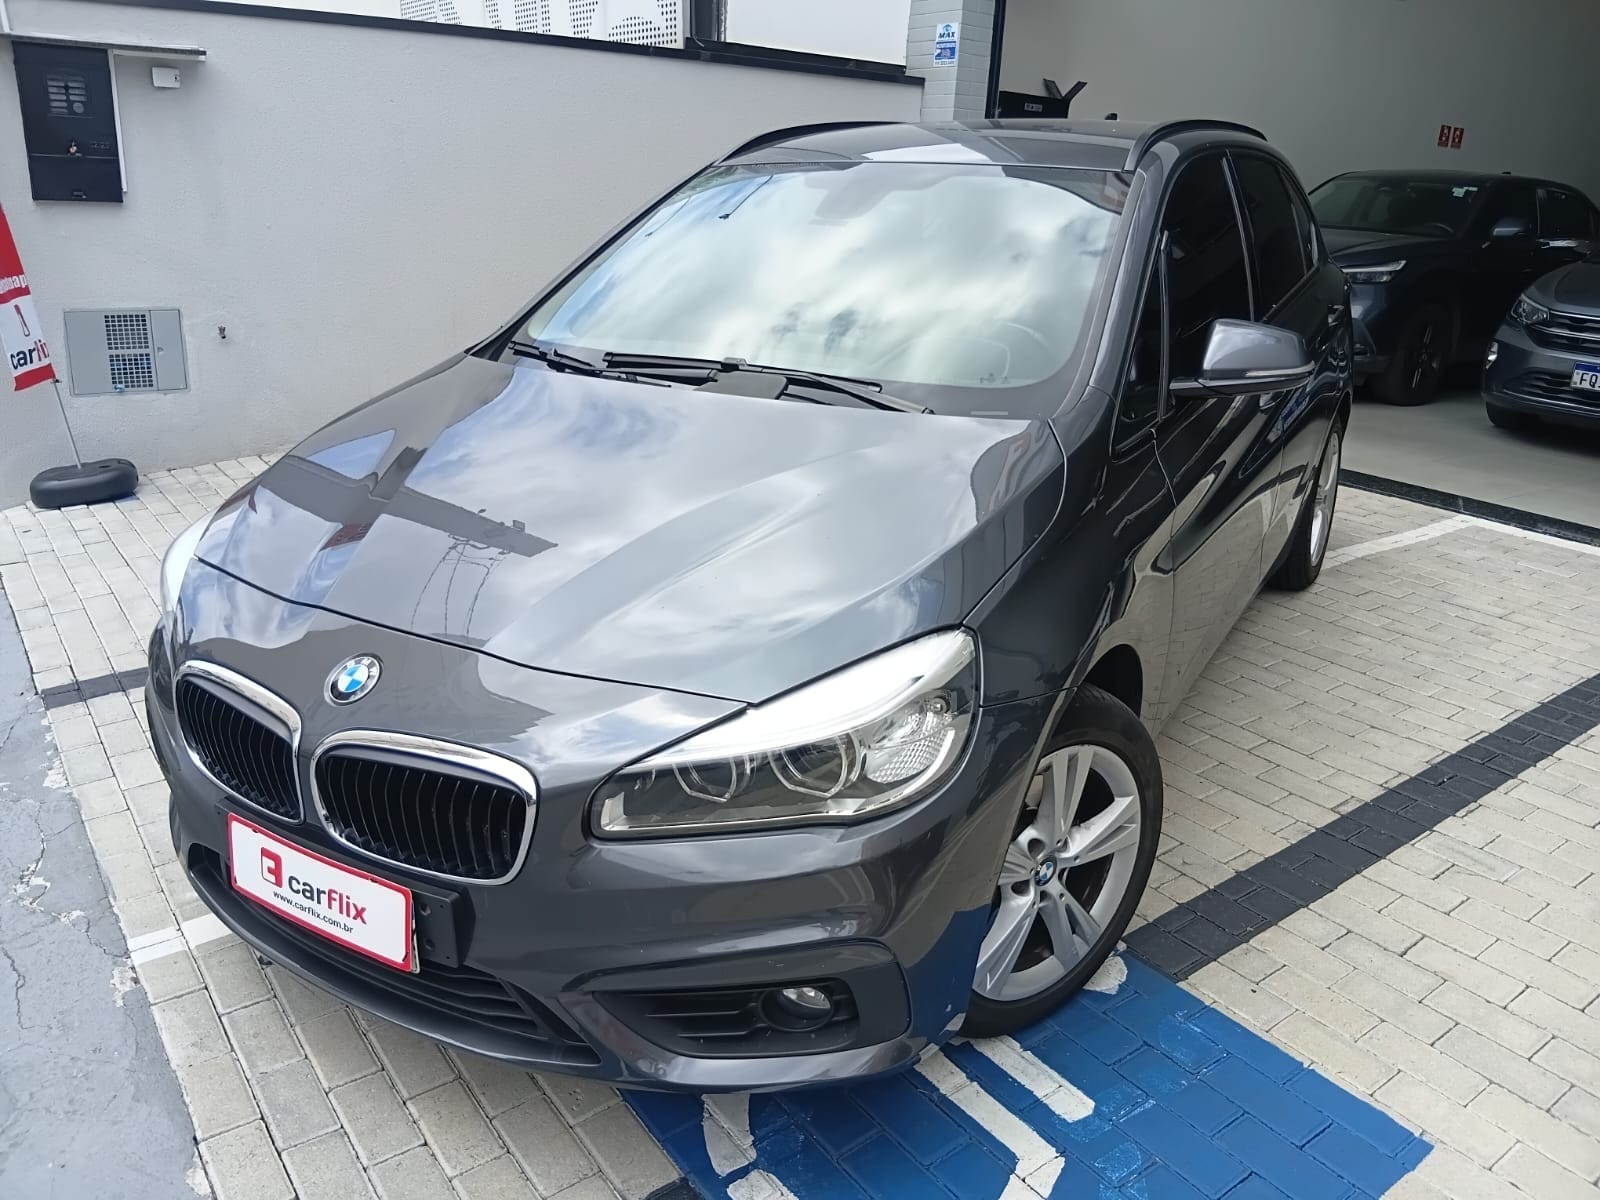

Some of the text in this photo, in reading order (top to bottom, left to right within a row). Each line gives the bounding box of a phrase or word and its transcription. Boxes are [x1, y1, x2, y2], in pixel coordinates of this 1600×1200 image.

[1579, 372, 1600, 389] FQ
[273, 890, 354, 934] www.carflix.com.br
[288, 875, 367, 926] carflix
